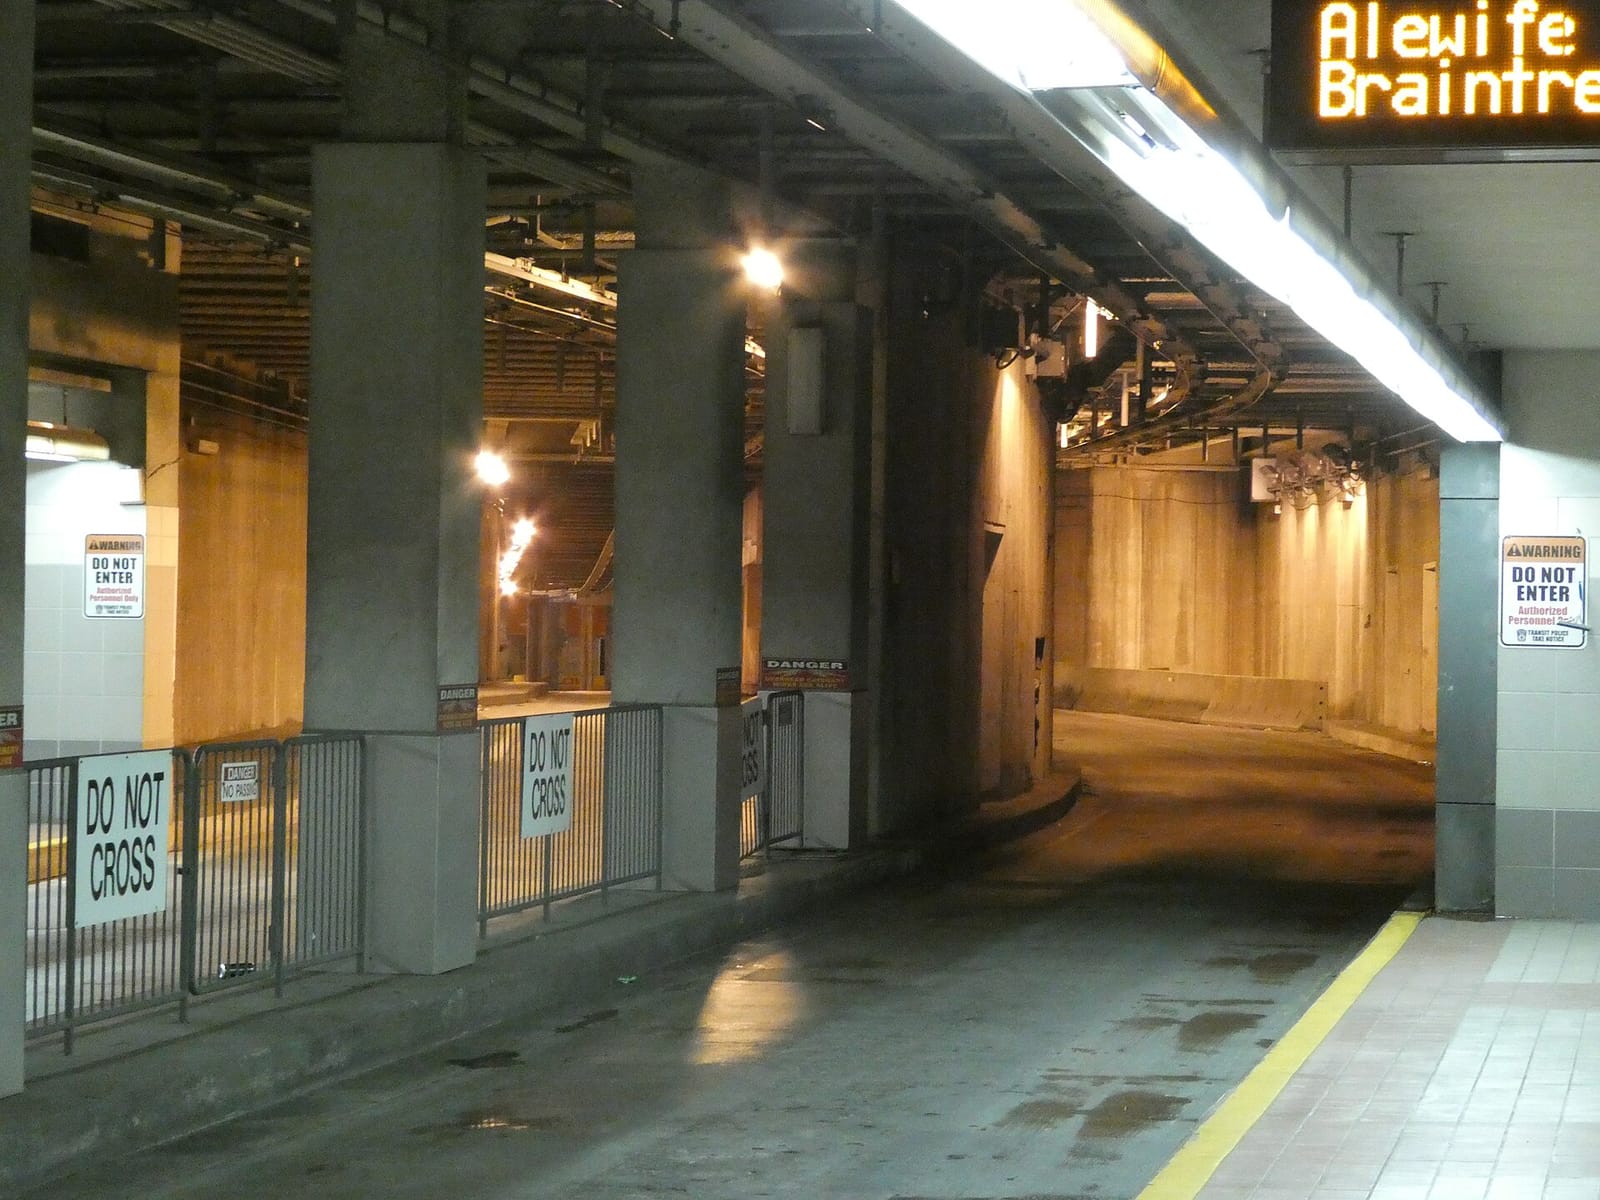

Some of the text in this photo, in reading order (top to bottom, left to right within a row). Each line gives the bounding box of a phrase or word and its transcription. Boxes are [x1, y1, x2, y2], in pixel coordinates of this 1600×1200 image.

[1319, 0, 1576, 59] Alewife
[99, 540, 141, 551] WARNING
[1522, 544, 1581, 558] WARNING
[92, 557, 137, 570] DO NOT
[95, 571, 133, 584] ENTER
[1512, 566, 1576, 584] DO NOT
[124, 595, 139, 603] Only
[1517, 585, 1570, 602] ENTER
[1518, 605, 1568, 616] Authorized
[1508, 615, 1555, 626] Personnel
[767, 660, 843, 670] DANGER
[440, 688, 476, 700] DANGER
[529, 728, 571, 773] DO NOT
[227, 766, 256, 780] DANGER
[222, 784, 234, 799] NO
[531, 773, 567, 820] CROSS
[86, 771, 165, 836] DO NOT
[90, 834, 156, 902] CROSS
